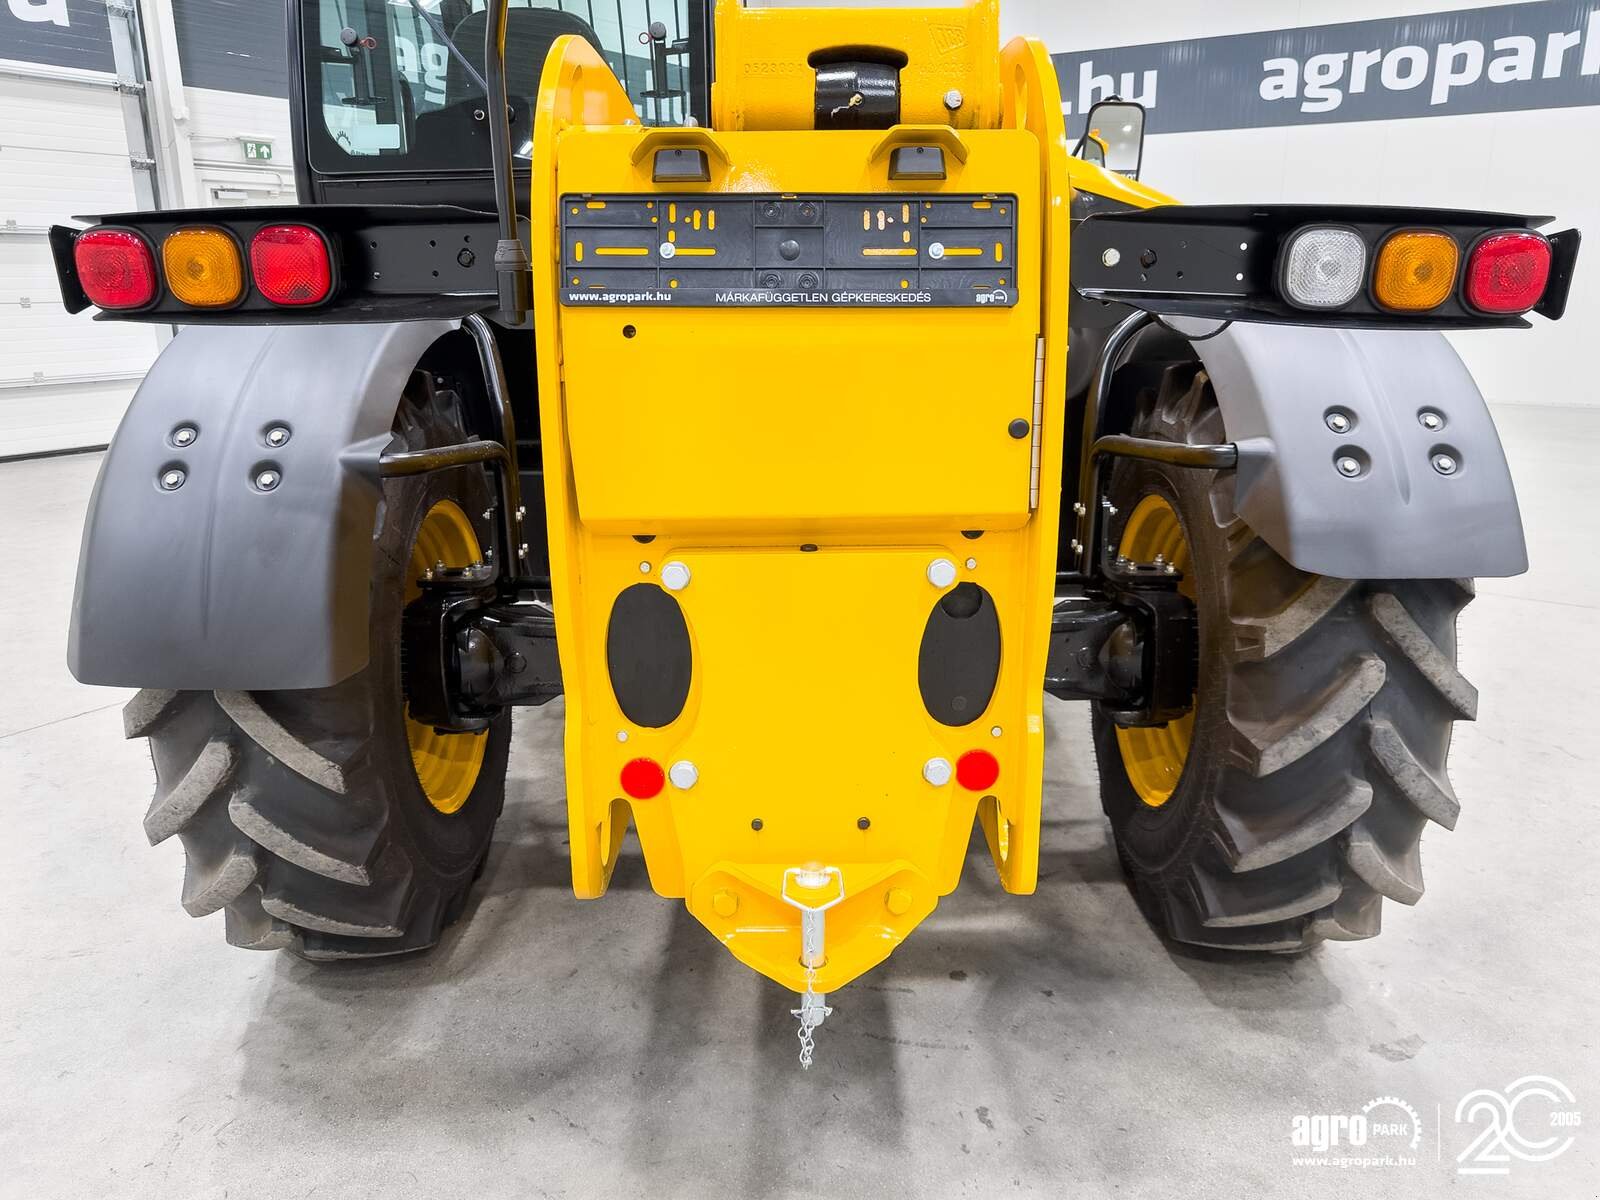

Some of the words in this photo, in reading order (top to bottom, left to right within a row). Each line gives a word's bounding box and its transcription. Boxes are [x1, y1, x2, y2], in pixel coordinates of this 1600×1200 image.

[568, 291, 672, 303] www.agropark.hu
[715, 289, 829, 303] MÁRKAFÜGGETLEN
[831, 289, 932, 303] GÉPKERESKEDÉS
